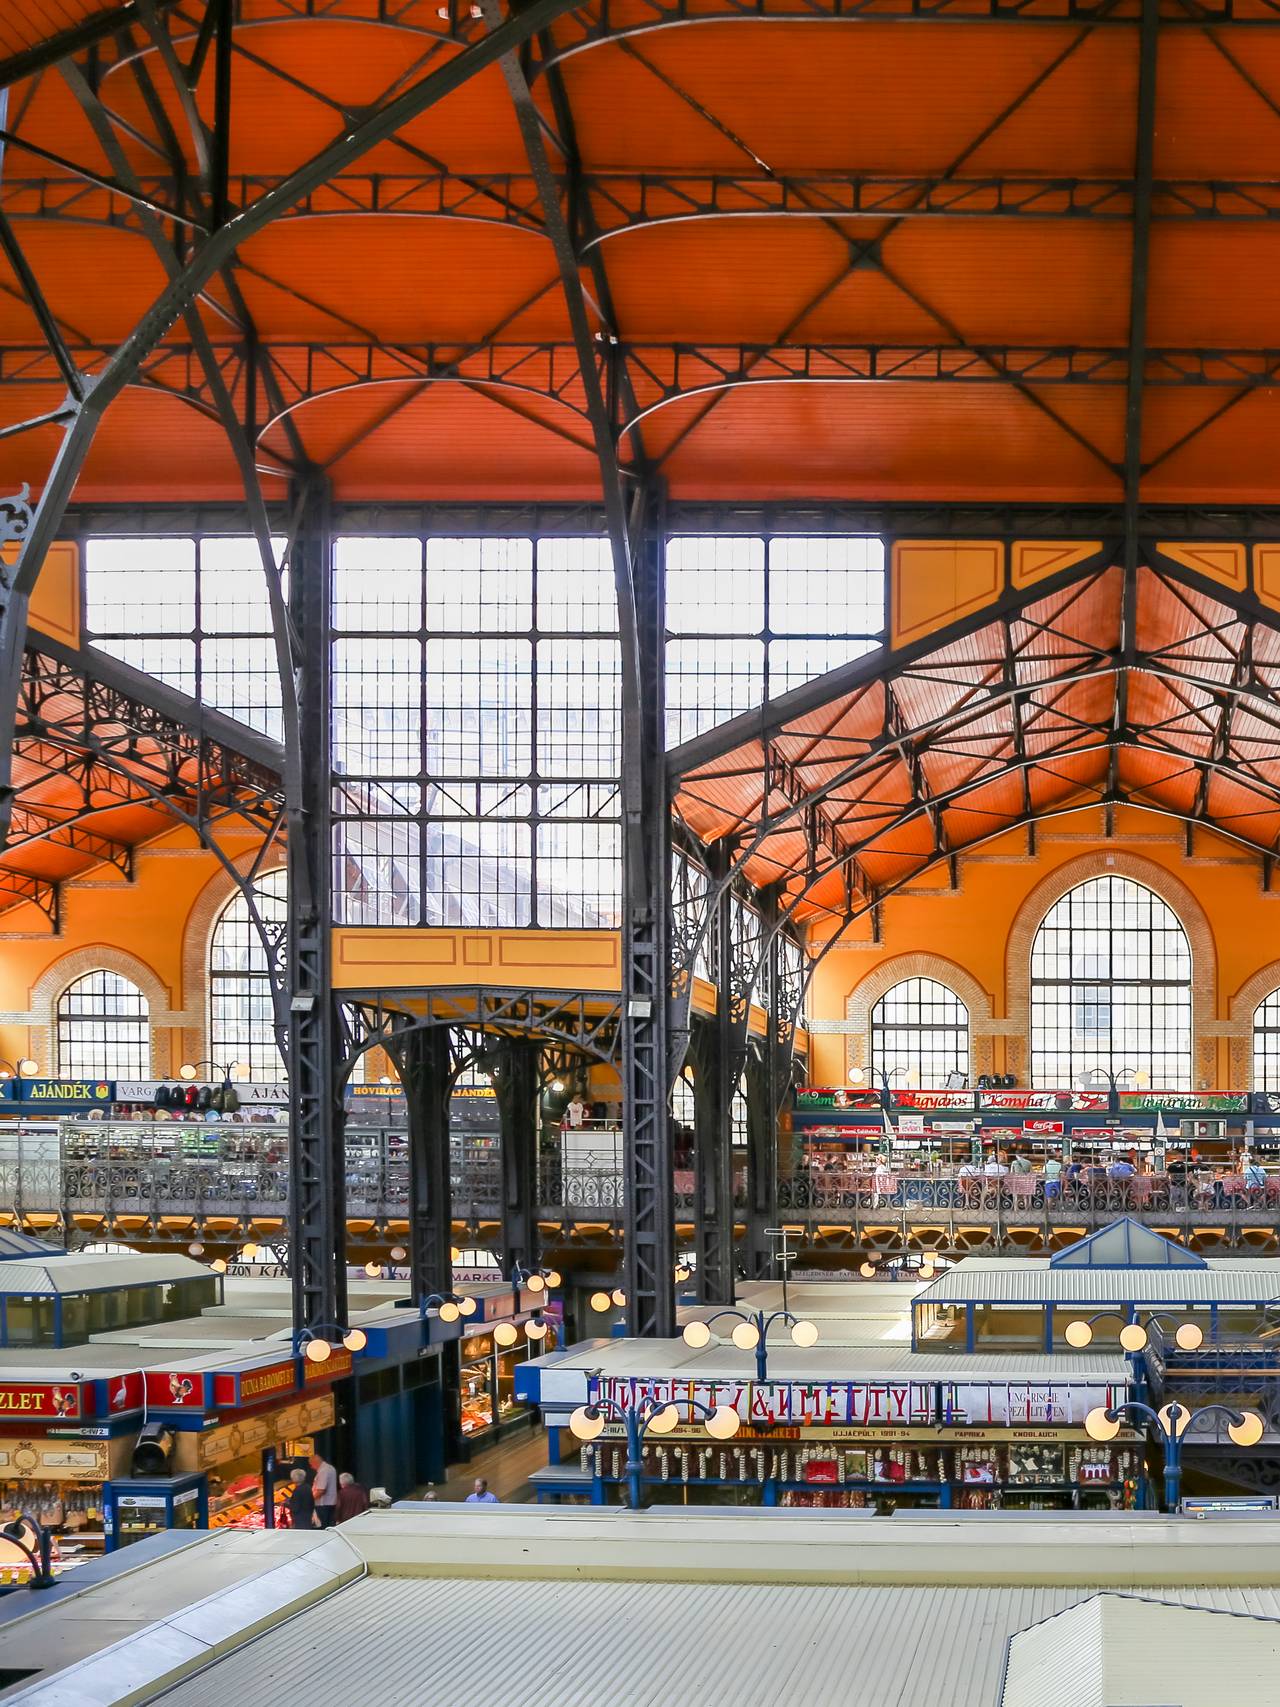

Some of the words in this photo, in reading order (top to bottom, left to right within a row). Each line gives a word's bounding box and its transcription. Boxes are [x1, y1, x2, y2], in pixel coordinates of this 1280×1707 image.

[30, 1081, 92, 1098] AJÁNDÉK
[121, 1087, 156, 1097] VARG
[251, 1085, 289, 1098] AJÁN
[896, 1093, 968, 1109] Magyaros
[985, 1094, 1045, 1110] Konyha
[452, 1273, 502, 1281] MARKE
[0, 1392, 45, 1410] ZLET
[752, 1389, 769, 1416] &
